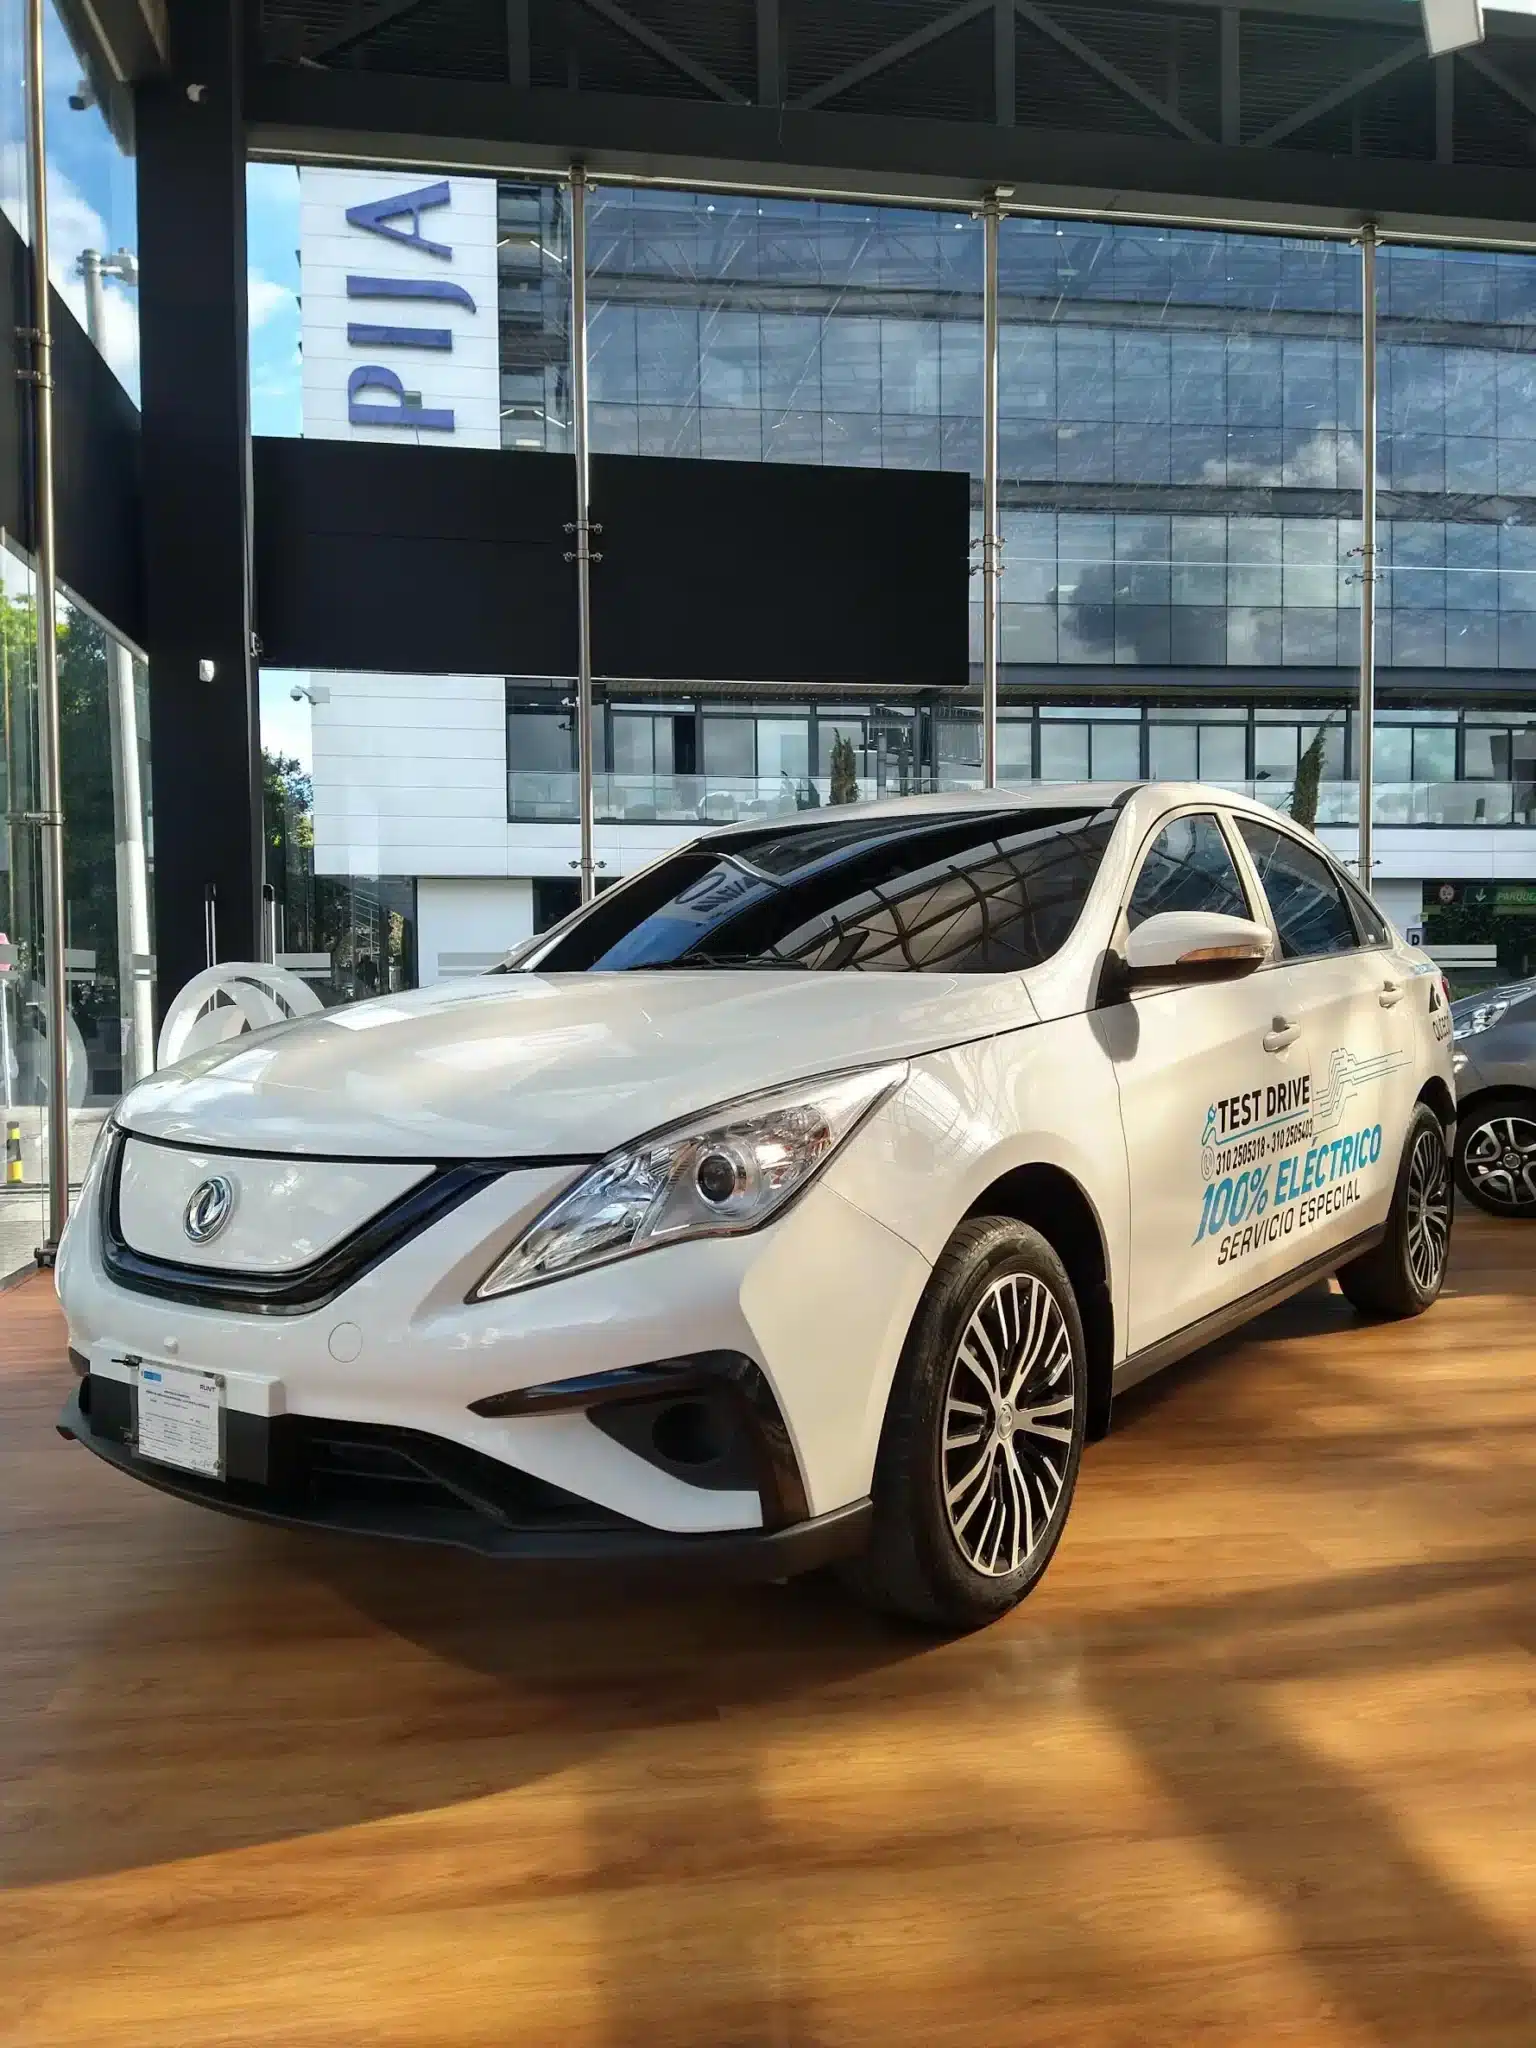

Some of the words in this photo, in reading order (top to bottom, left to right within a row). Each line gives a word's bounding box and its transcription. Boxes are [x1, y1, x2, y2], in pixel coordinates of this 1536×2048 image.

[346, 180, 476, 432] PIJA
[1218, 1092, 1261, 1133] TEST
[1267, 1075, 1310, 1117] DRIVE
[1192, 1164, 1271, 1246] 100%
[1274, 1124, 1382, 1206] ELÉCTRICO
[1216, 1152, 1231, 1175] 310
[1233, 1136, 1266, 1169] 2505318
[1272, 1131, 1284, 1153] 310
[1218, 1208, 1294, 1265] SERVICIO
[1300, 1178, 1360, 1227] ESPECIAL
